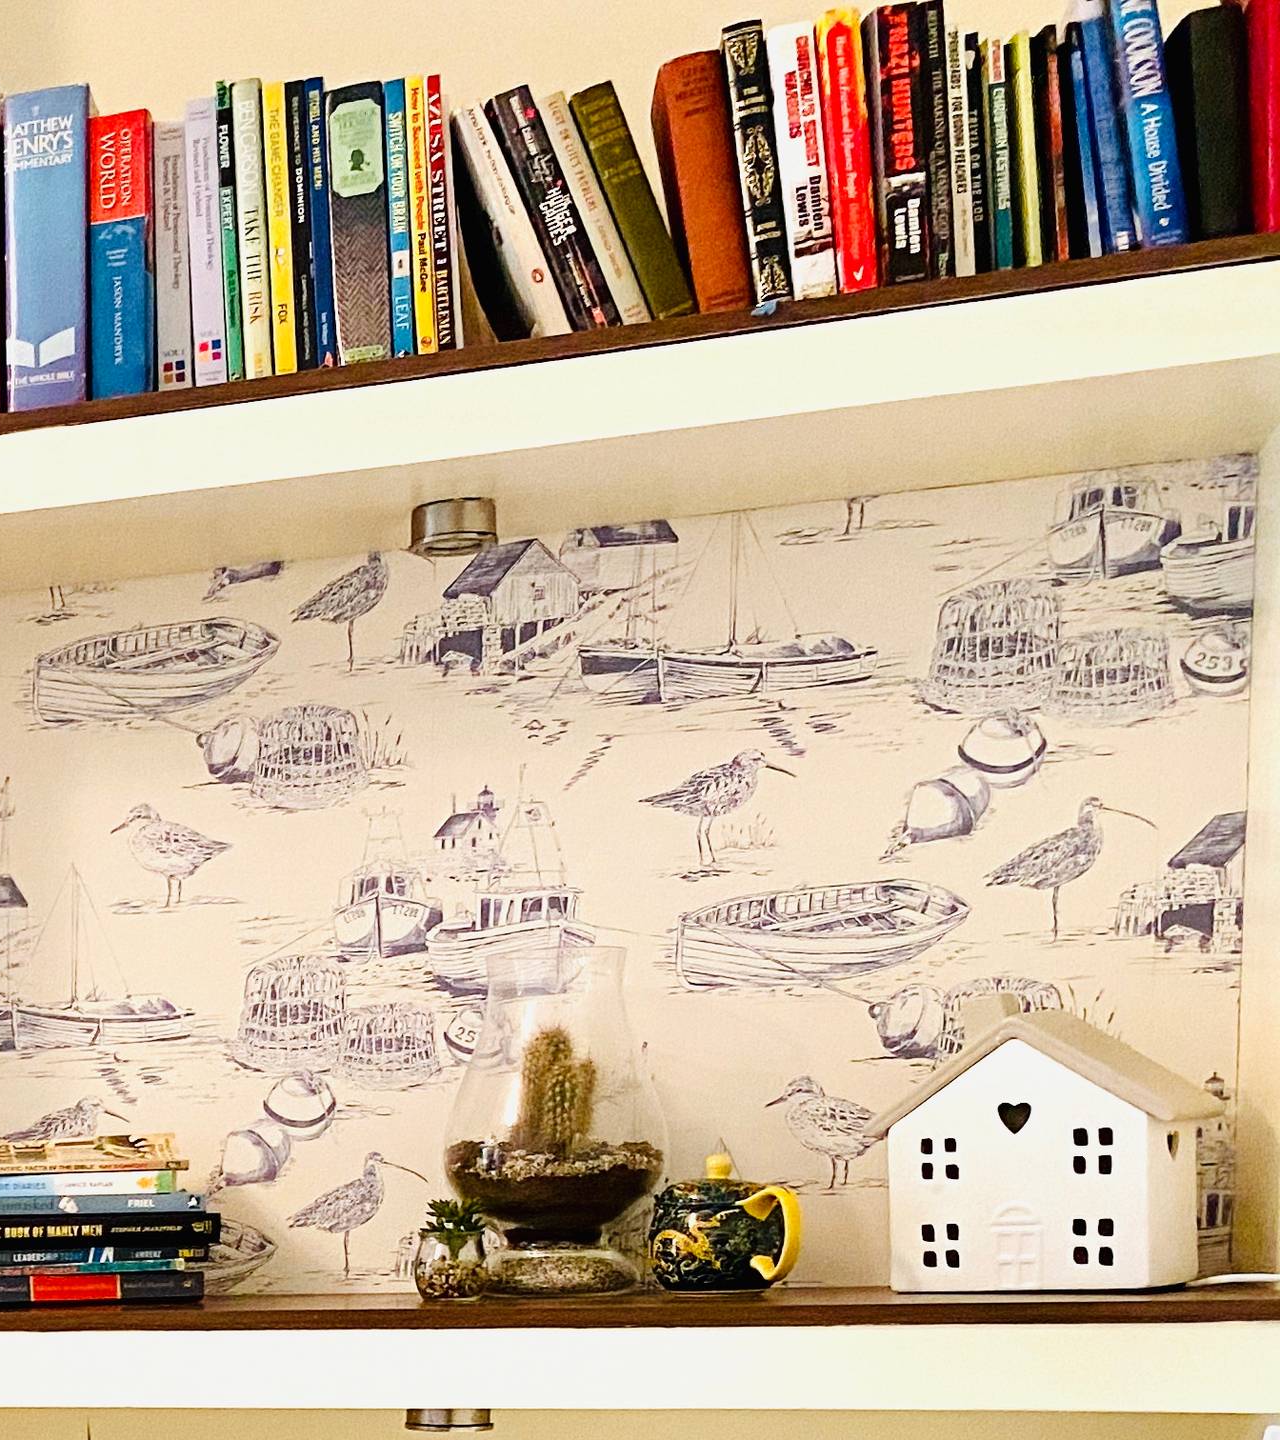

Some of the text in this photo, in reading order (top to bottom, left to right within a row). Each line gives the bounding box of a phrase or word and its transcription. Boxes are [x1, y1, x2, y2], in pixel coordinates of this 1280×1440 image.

[888, 26, 910, 75] NAZI
[1122, 18, 1164, 99] COOKSON
[269, 108, 280, 130] THE
[547, 100, 565, 127] LIGHT
[559, 129, 571, 142] ON
[891, 78, 917, 172] HUNTERS
[952, 96, 964, 112] FOR
[1140, 103, 1159, 116] A
[240, 100, 259, 197] BEN CARSON
[270, 131, 281, 165] GAME
[311, 124, 321, 164] AND HIS
[411, 88, 425, 231] How to Succeed with People
[803, 119, 821, 167] SECRET
[1141, 116, 1163, 160] House
[99, 132, 117, 209] WORLD
[119, 128, 133, 207] OPERATION
[218, 124, 233, 231] FLOWER EXPERT
[389, 111, 408, 235] SWITCH ON YOUR BRAIN
[428, 93, 449, 257] AZUSA STREET
[954, 148, 968, 195] PREACHERS
[971, 173, 982, 196] THE
[1148, 160, 1173, 213] Divided
[295, 166, 306, 224] DOMINION
[547, 186, 577, 238] HUNGER
[562, 193, 572, 204] THE
[795, 185, 810, 228] Lewis
[808, 175, 825, 232] Damien
[244, 208, 261, 247] TAKE
[539, 200, 568, 247] GAMES
[894, 207, 908, 249] Lewis
[906, 198, 922, 255] Damien
[417, 232, 429, 293] Paul McGee
[112, 275, 125, 366] JASON MANDRYK
[248, 291, 264, 326] RISK
[278, 303, 288, 325] FOX
[395, 295, 410, 331] LEAF
[436, 268, 452, 345] BARTLEMAN
[12, 1182, 47, 1190] DIARIES
[127, 1199, 155, 1208] FRIEL
[4, 1227, 31, 1239] BOOK
[32, 1226, 44, 1238] OF
[46, 1225, 80, 1238] MANLY
[81, 1224, 103, 1237] MEN
[13, 1252, 59, 1263] LEADERSHIP
